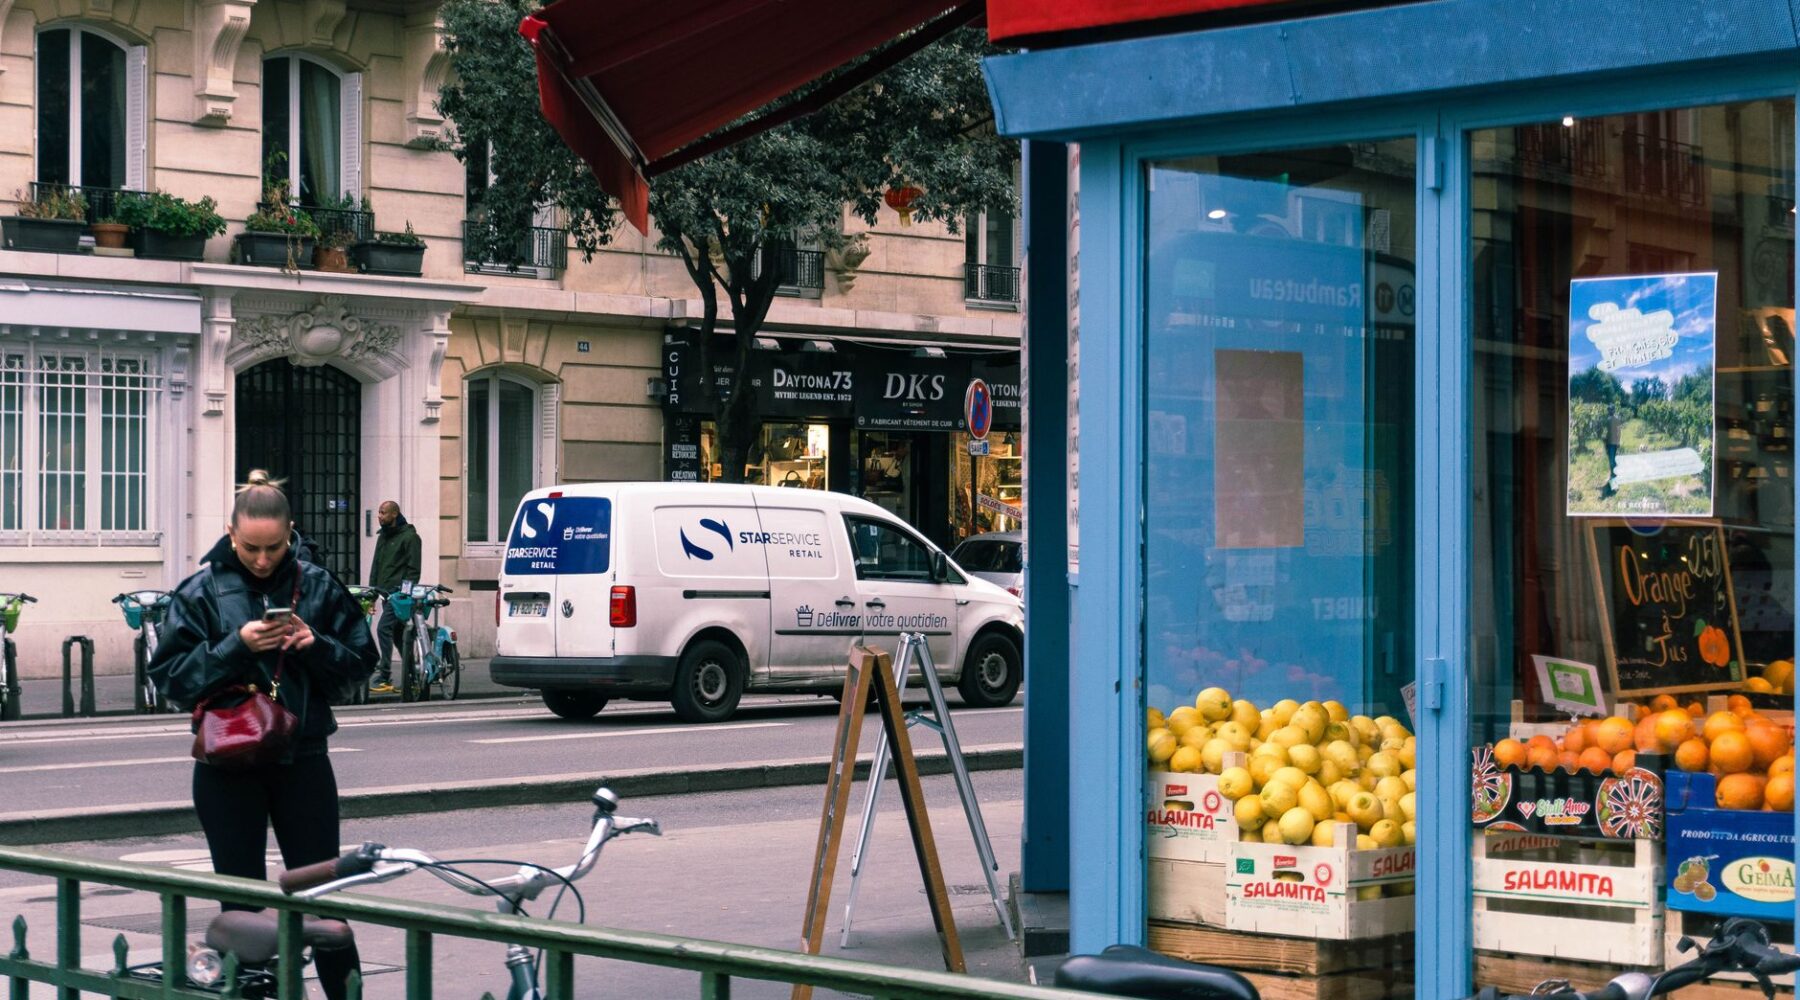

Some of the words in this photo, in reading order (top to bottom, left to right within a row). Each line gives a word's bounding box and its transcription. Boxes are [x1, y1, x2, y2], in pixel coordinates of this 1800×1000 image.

[669, 352, 679, 404] CUIR
[883, 373, 945, 400] DKS
[774, 391, 798, 399] MYTHIC
[799, 392, 822, 400] LEGEND
[823, 393, 836, 401] EST.
[996, 400, 1017, 408] LEGEND
[789, 550, 822, 558] RETAIL
[1621, 544, 1696, 618] Orange
[817, 611, 861, 627] Délivrer
[866, 613, 895, 627] votre
[897, 611, 948, 632] quotidien
[1648, 633, 1688, 667] Jus
[1147, 809, 1214, 830] ALAMITA
[1373, 851, 1415, 877] SALA
[1243, 881, 1326, 903] SALAMITA
[1504, 869, 1613, 897] SALAMITA
